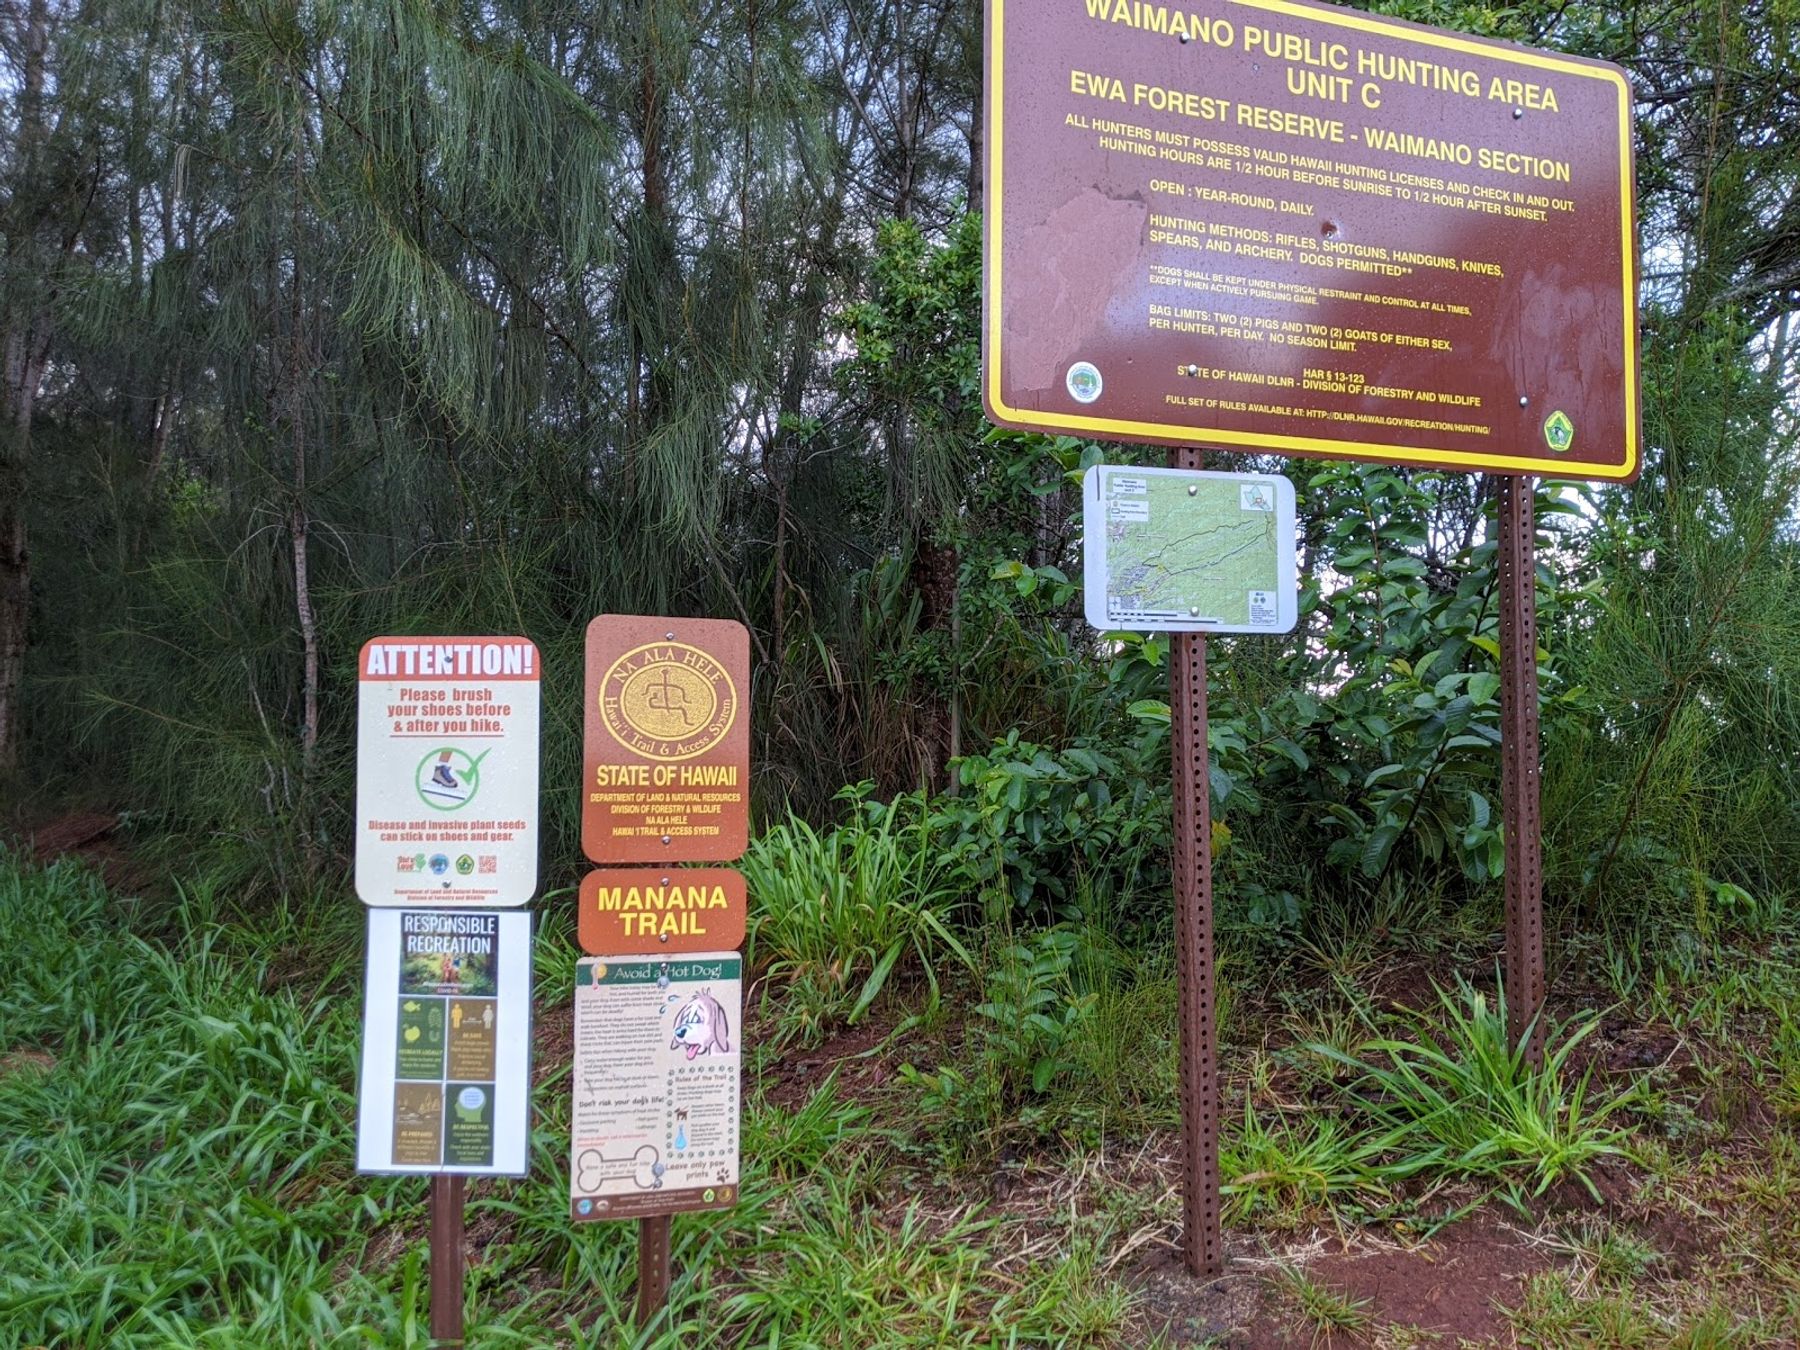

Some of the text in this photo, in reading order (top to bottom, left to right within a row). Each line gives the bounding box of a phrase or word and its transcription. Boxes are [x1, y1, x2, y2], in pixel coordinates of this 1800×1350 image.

[1085, 0, 1558, 112] WAIMANO PUBLIC HUNTING AREA
[1287, 66, 1381, 108] UNIT C
[1070, 69, 1126, 102] EWA
[1133, 83, 1230, 121] FOREST
[1237, 103, 1344, 143] RESERVE
[1363, 126, 1472, 165] WAIMANO
[1477, 147, 1570, 182] SECTION
[1064, 112, 1575, 212] ALL HUNTERS MUST POSSESS VALID HAWAII HUNTING LICENSES AND CHECK IN AND OUT.
[1099, 135, 1547, 221] HUNTING HOURS ARE 1/2 HOUR BEFORE SUNRISE TO 1/2 HOUR AFTER SUNSET.
[1149, 178, 1184, 195] OPEN
[1194, 185, 1277, 211] YEAR-ROUND,
[1280, 199, 1314, 216] DAILY.
[1149, 213, 1504, 277] HUNTING METHODS: RIFLES, SHOTGUNS, HANDGUNS, KNIVES,
[1149, 229, 1202, 250] SPEARS,
[1204, 238, 1232, 252] AND
[1234, 242, 1293, 261] ARCHERY.
[1299, 251, 1334, 267] DOGS
[1149, 273, 1319, 305] EXCEPT WHEN ACTIVELY PURSUING GAME.
[1183, 268, 1210, 281] SHALL
[1211, 272, 1223, 282] BE
[1224, 275, 1246, 285] KEPT
[1247, 278, 1276, 289] UNDER
[1277, 282, 1317, 295] PHYSICAL
[1318, 287, 1362, 300] RESTRAINT
[1363, 293, 1381, 303] AND
[1381, 295, 1419, 308] CONTROL
[1419, 300, 1430, 309] AT
[1430, 302, 1446, 312] ALL
[1446, 304, 1472, 316] TIMES,
[1148, 303, 1452, 351] BAG LIMITS: TWO (2) PIGS AND TWO (2) GOATS OF EITHER SEX,
[1148, 316, 1357, 351] PER HUNTER, PER DAY. NO SEASON LIMIT.
[1176, 363, 1211, 380] STTE
[1211, 368, 1226, 379] OF
[1228, 370, 1264, 384] HAWAII
[1266, 374, 1294, 387] DLNR
[1302, 378, 1346, 392] DIVISION
[1347, 383, 1361, 394] OF
[1363, 384, 1414, 399] FORESTRY
[1415, 390, 1436, 402] AND
[1437, 392, 1481, 407] WILDLIFE
[1302, 367, 1365, 384] HAR § 13-123
[366, 644, 534, 676] ATTENTION!
[611, 647, 724, 685] NĀ ALA HELE
[387, 702, 511, 718] your shoes before
[400, 687, 492, 702] Please brush
[393, 718, 504, 734] & after you hike.
[630, 731, 657, 754] Trail
[659, 742, 671, 756] &
[674, 734, 711, 756] Access
[708, 698, 732, 737] System
[597, 764, 737, 786] STATE OF HAWAII
[368, 819, 527, 831] Disease and invasive plant seeds
[380, 831, 514, 843] can stick on shoes and gear.
[598, 885, 728, 911] MANANA
[404, 915, 495, 935] RESPONSIBLE
[618, 911, 706, 936] TRAIL
[407, 935, 491, 955] RECREATION
[613, 963, 652, 980] Avoid
[691, 963, 723, 981] Dog!
[685, 1170, 710, 1182] prints
[690, 1161, 707, 1170] only
[709, 1160, 726, 1170] paw
